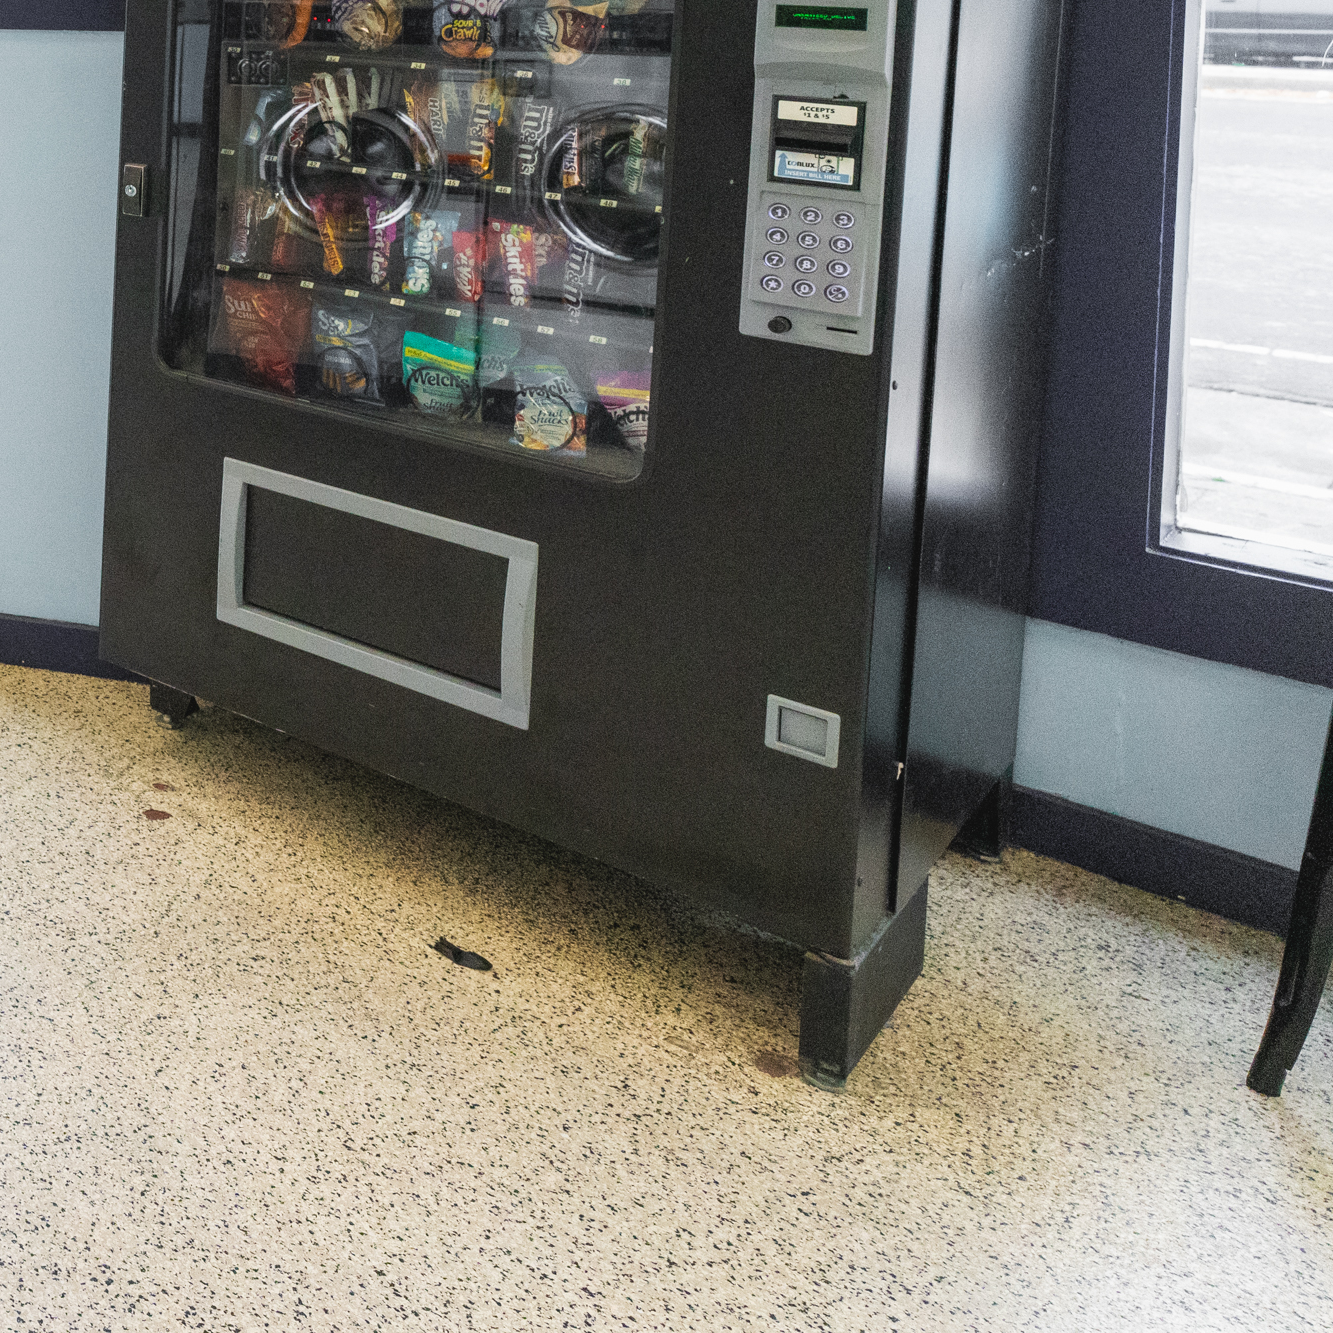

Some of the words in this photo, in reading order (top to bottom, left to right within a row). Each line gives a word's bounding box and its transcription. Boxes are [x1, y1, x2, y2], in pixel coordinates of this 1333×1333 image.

[806, 212, 815, 220] 2
[839, 216, 848, 224] 3
[805, 236, 812, 244] 5
[771, 256, 779, 264] 7
[802, 261, 811, 269] 8
[501, 233, 527, 307] Skittles
[412, 368, 470, 388] Welch's
[530, 416, 569, 426] Snacks
